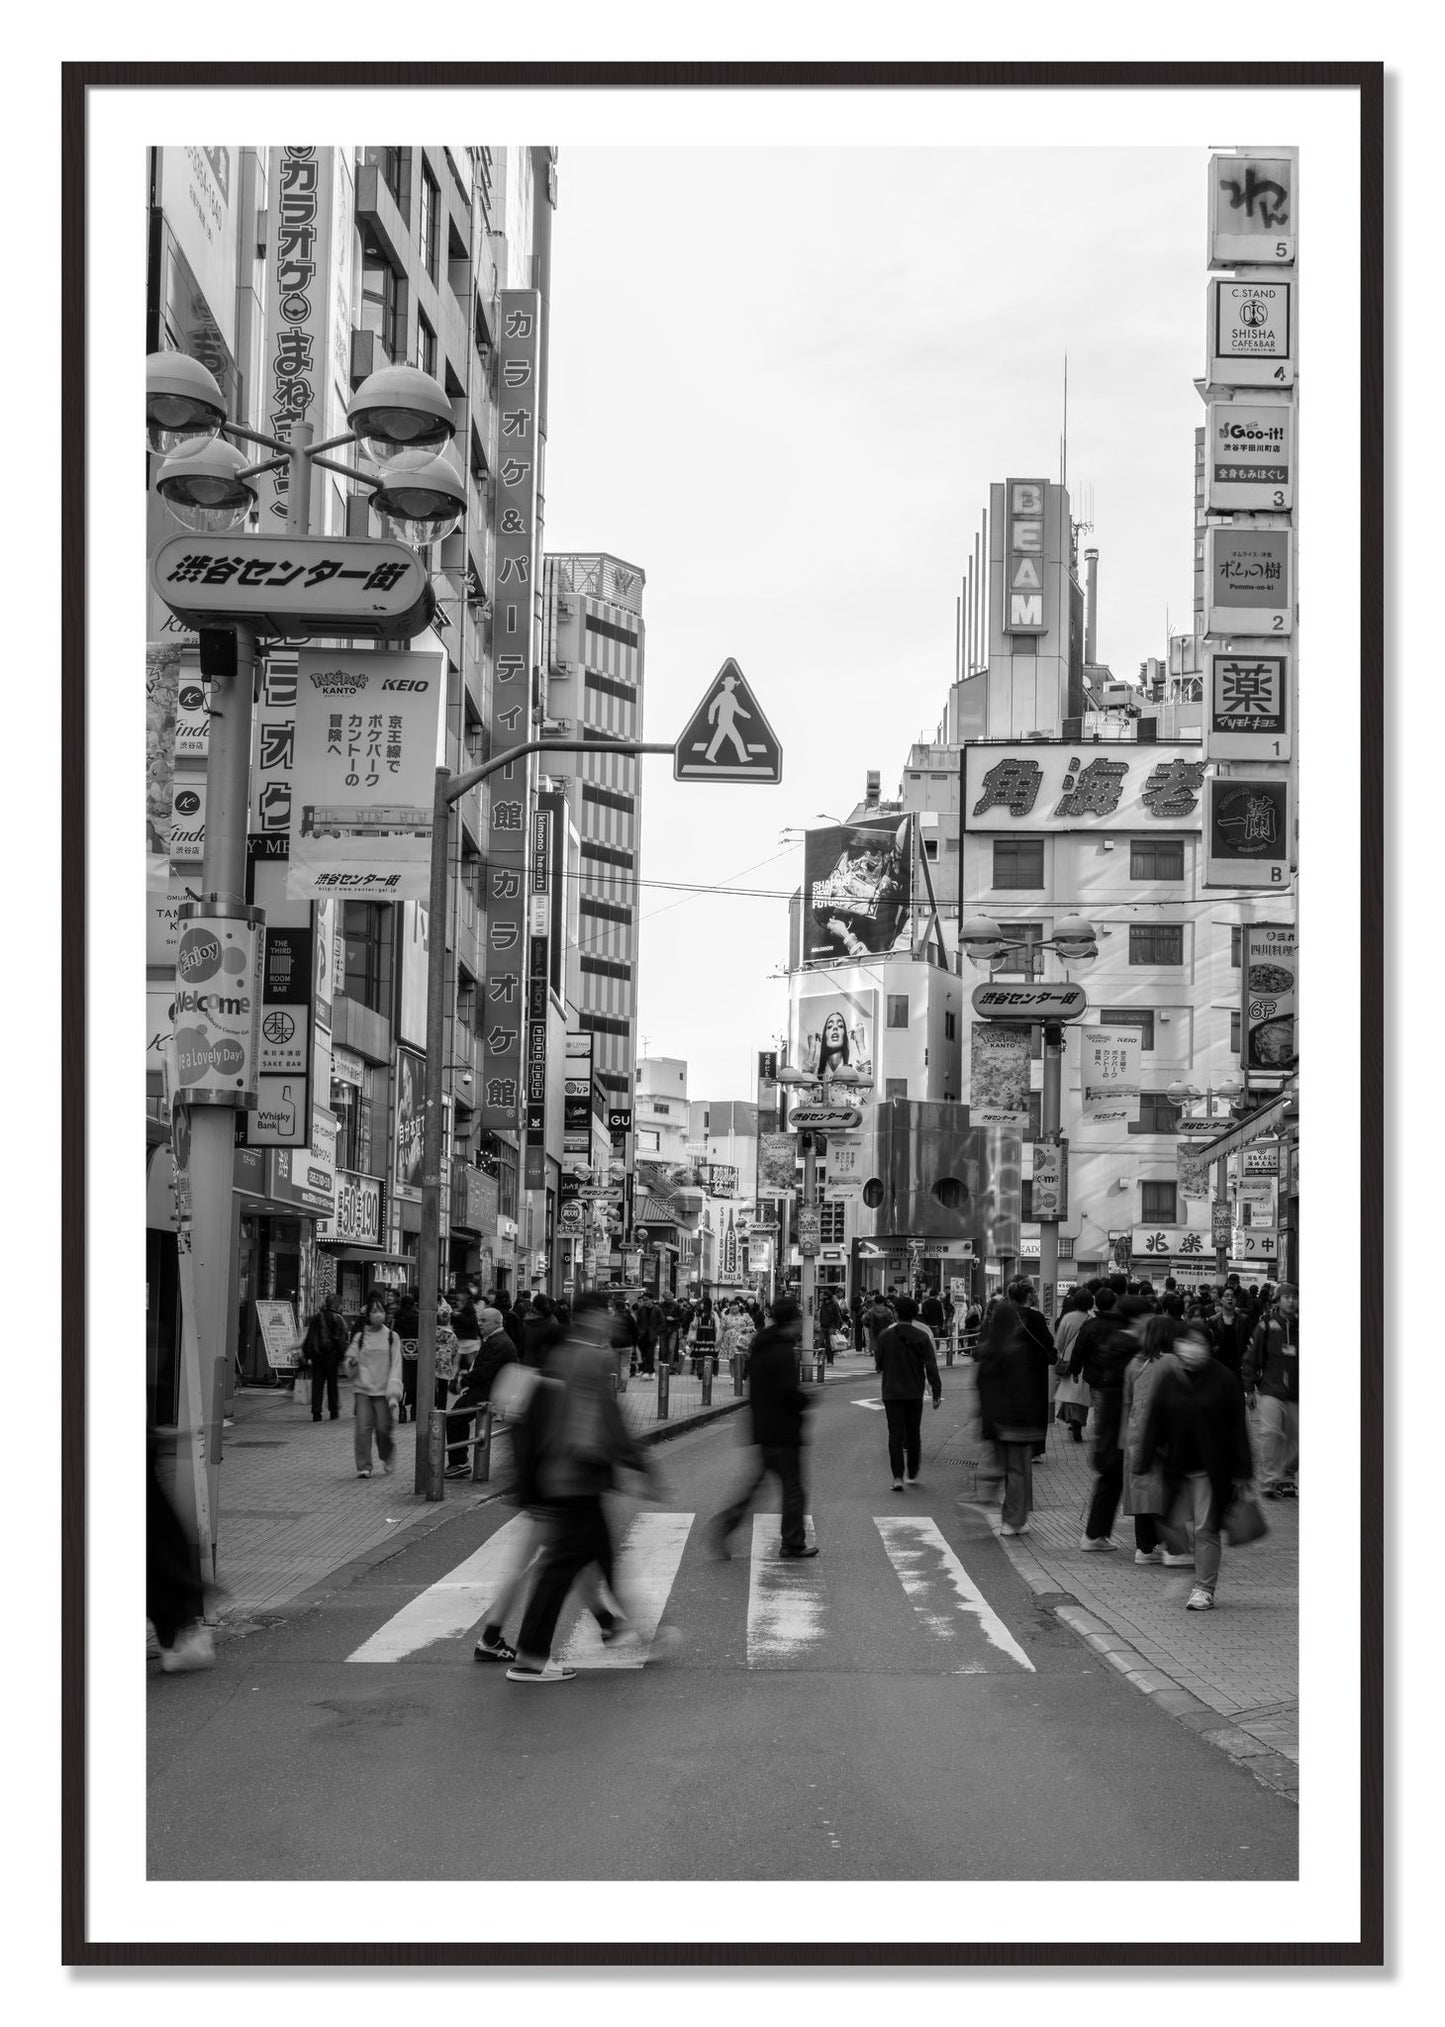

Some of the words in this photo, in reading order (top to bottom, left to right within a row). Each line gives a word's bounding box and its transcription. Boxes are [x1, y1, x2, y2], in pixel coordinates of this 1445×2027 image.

[276, 159, 318, 293] カラオケ
[1275, 242, 1288, 257] 5
[1231, 288, 1276, 298] C.STAND
[1231, 328, 1276, 340] SHISHA
[1231, 339, 1276, 348] CAFE&BAR
[1273, 366, 1287, 381] 4
[1230, 424, 1284, 440] Goo-it!
[1223, 443, 1281, 452] 渋谷宇田川町店
[1218, 468, 1285, 480] 全身もみほぐし
[1273, 490, 1285, 507] 3
[1011, 484, 1042, 624] BEAM
[166, 555, 411, 592] 渋谷センター街
[1229, 583, 1274, 591] Pomme-no-ki
[1272, 615, 1284, 631] 2
[322, 687, 357, 695] KANTO
[381, 679, 429, 692] KEIO
[1222, 663, 1272, 713] 薬
[327, 714, 343, 755] 冒険へ
[180, 741, 203, 749] 渋谷店
[345, 714, 362, 787] カントーの
[386, 715, 403, 773] 京王線で
[1272, 741, 1280, 756] 1
[972, 757, 1204, 817] 角海老
[537, 816, 546, 850] kimono
[175, 846, 200, 854] 渋谷店
[314, 873, 402, 886] 渋谷センター街
[536, 855, 546, 889] hearts
[1271, 867, 1283, 882] B
[180, 941, 218, 975] Enjoy
[486, 870, 520, 1108] カラオケ館
[175, 990, 250, 1015] Welcome
[979, 992, 1080, 1005] 渋谷センター街
[1249, 1001, 1277, 1020] 6F
[192, 1047, 220, 1065] Lovely
[258, 1111, 290, 1124] Whisky
[610, 1115, 631, 1126] GU
[791, 1112, 853, 1121] 渋谷センター街
[257, 1121, 277, 1130] Bank
[1180, 1120, 1236, 1131] 渋谷センター街
[727, 1230, 736, 1272] BEER
